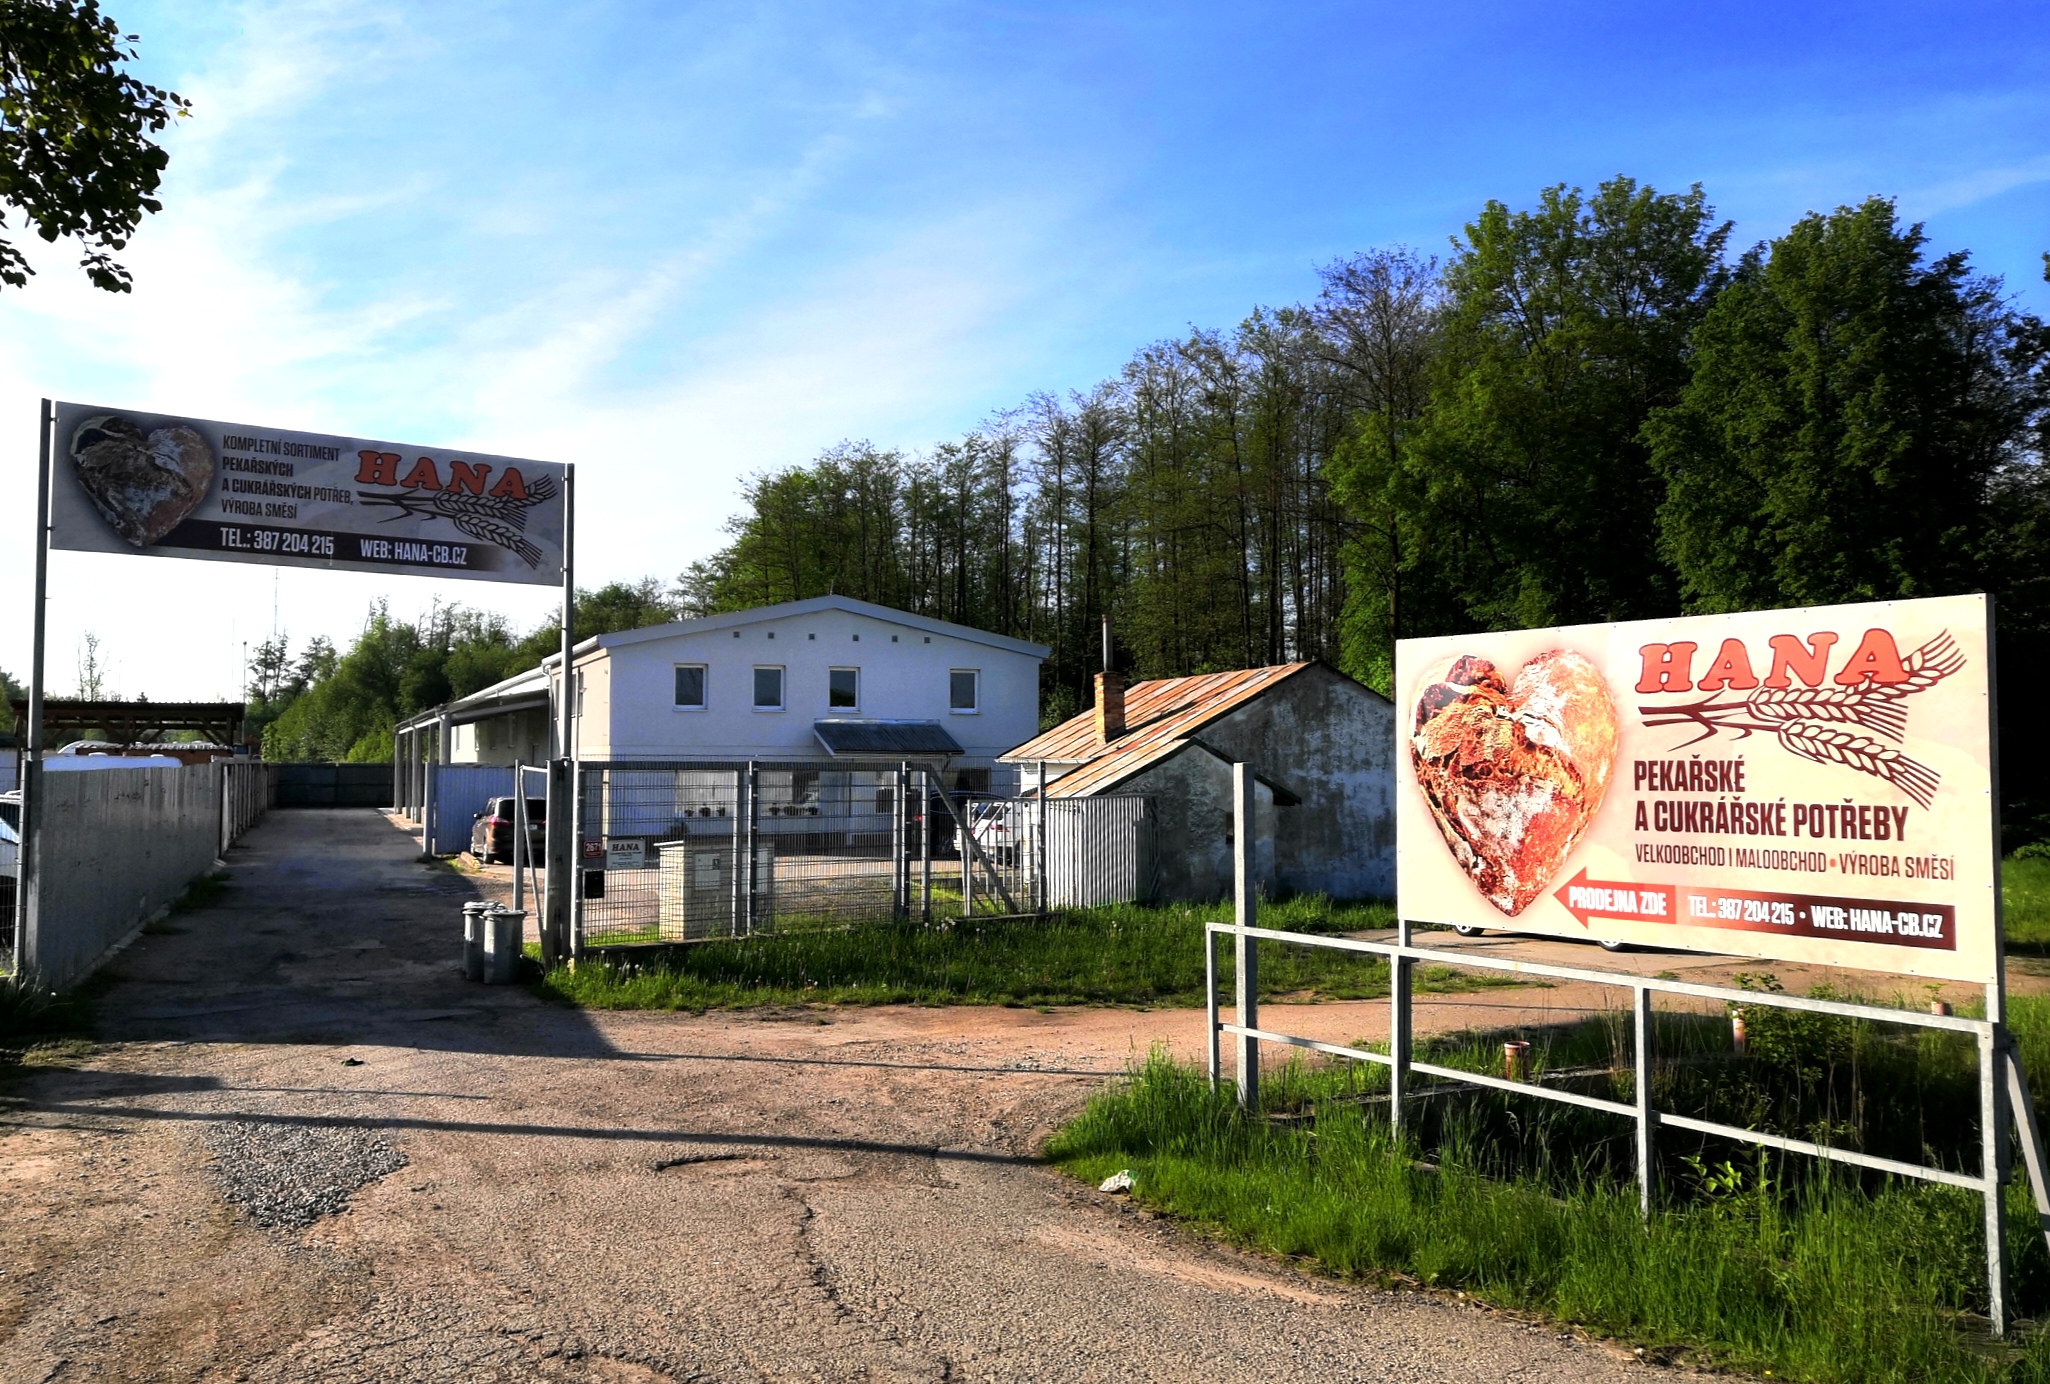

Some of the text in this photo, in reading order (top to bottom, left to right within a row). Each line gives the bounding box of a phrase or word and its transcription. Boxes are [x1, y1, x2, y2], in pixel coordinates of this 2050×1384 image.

[223, 435, 340, 462] KOMPLETNÍ SORTIMENT
[222, 456, 294, 477] PEKAŘSKÝCH
[354, 450, 528, 499] HANA
[221, 477, 354, 506] A CUKRÁŘSKÝCH POTŘEB,
[221, 497, 297, 519] VÝROBA SMĚSÍ
[220, 527, 335, 555] TEL.: 387 204 215
[360, 538, 467, 565] WEB: HANA-CB.CZ
[1635, 628, 1910, 694] HANA
[1634, 754, 1745, 792] PEKAŘSKÉ
[1635, 796, 1909, 841] A CUKRÁŘSKÉ POTŘEBY
[612, 843, 640, 851] HANA
[1635, 843, 1725, 867] VELKOOBCHOD
[1735, 849, 1827, 873] MALOOBCHOD
[1839, 850, 1900, 878] VÝROBA
[1905, 854, 1954, 881] SMĚSÍ
[1568, 886, 1667, 916] PRODEJNA ZDE
[1688, 895, 1944, 939] TEL.: 387 204 215 WEB: HANA-CB.CZ
